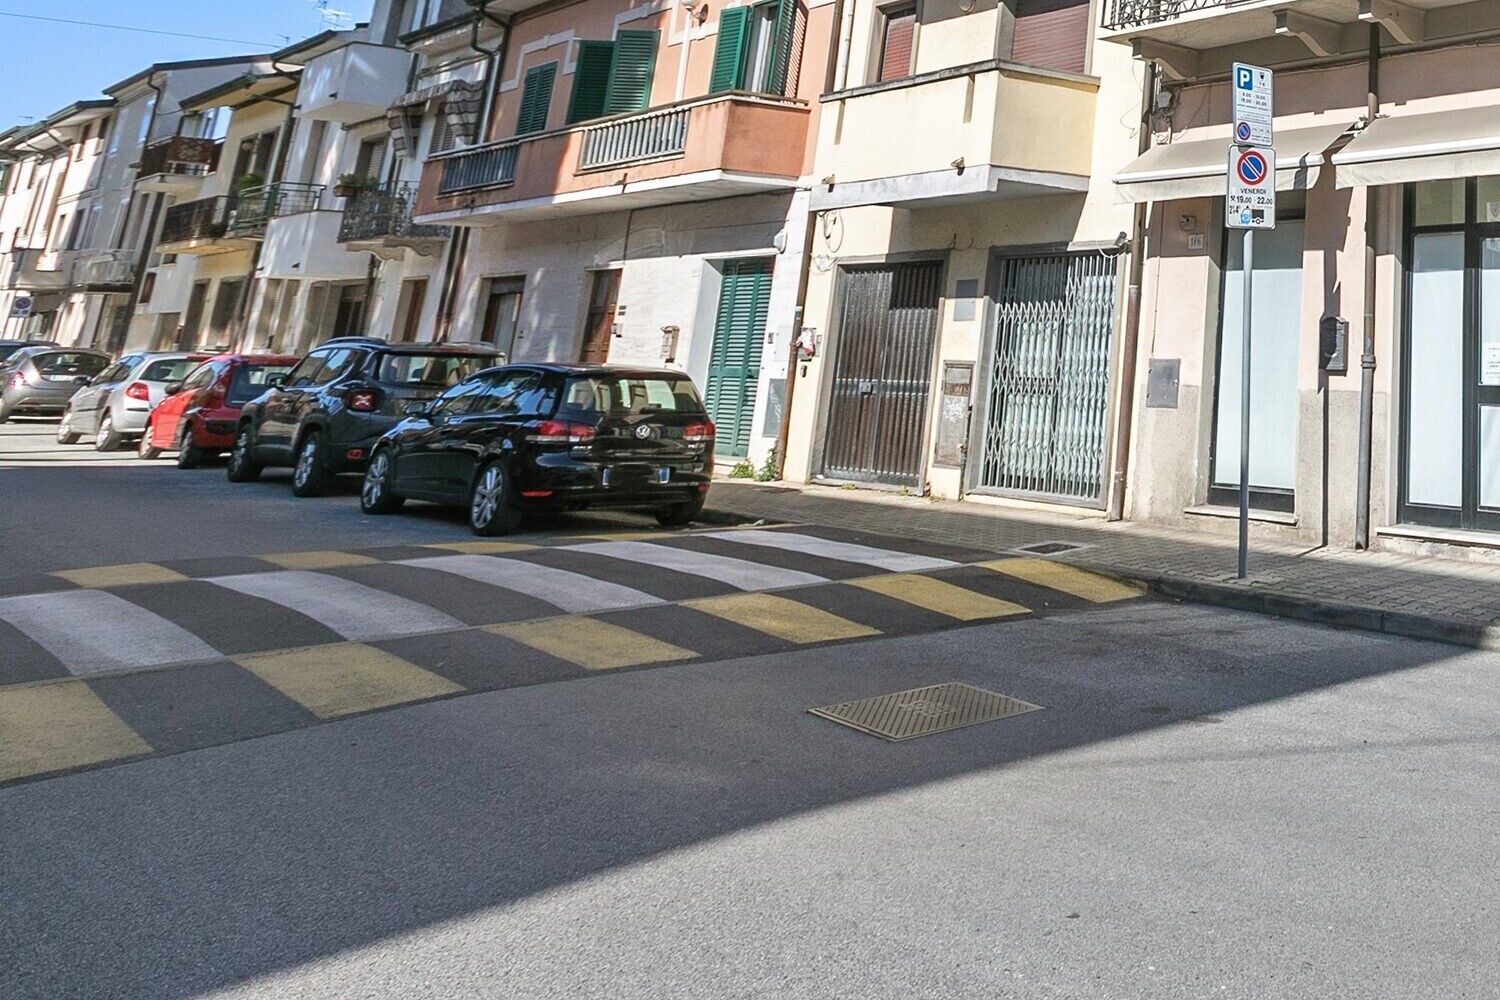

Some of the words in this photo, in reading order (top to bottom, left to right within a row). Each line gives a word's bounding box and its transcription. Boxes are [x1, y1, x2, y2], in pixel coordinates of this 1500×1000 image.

[1240, 70, 1250, 87] P
[1236, 195, 1252, 203] 19.00
[1257, 196, 1273, 205] 22.00
